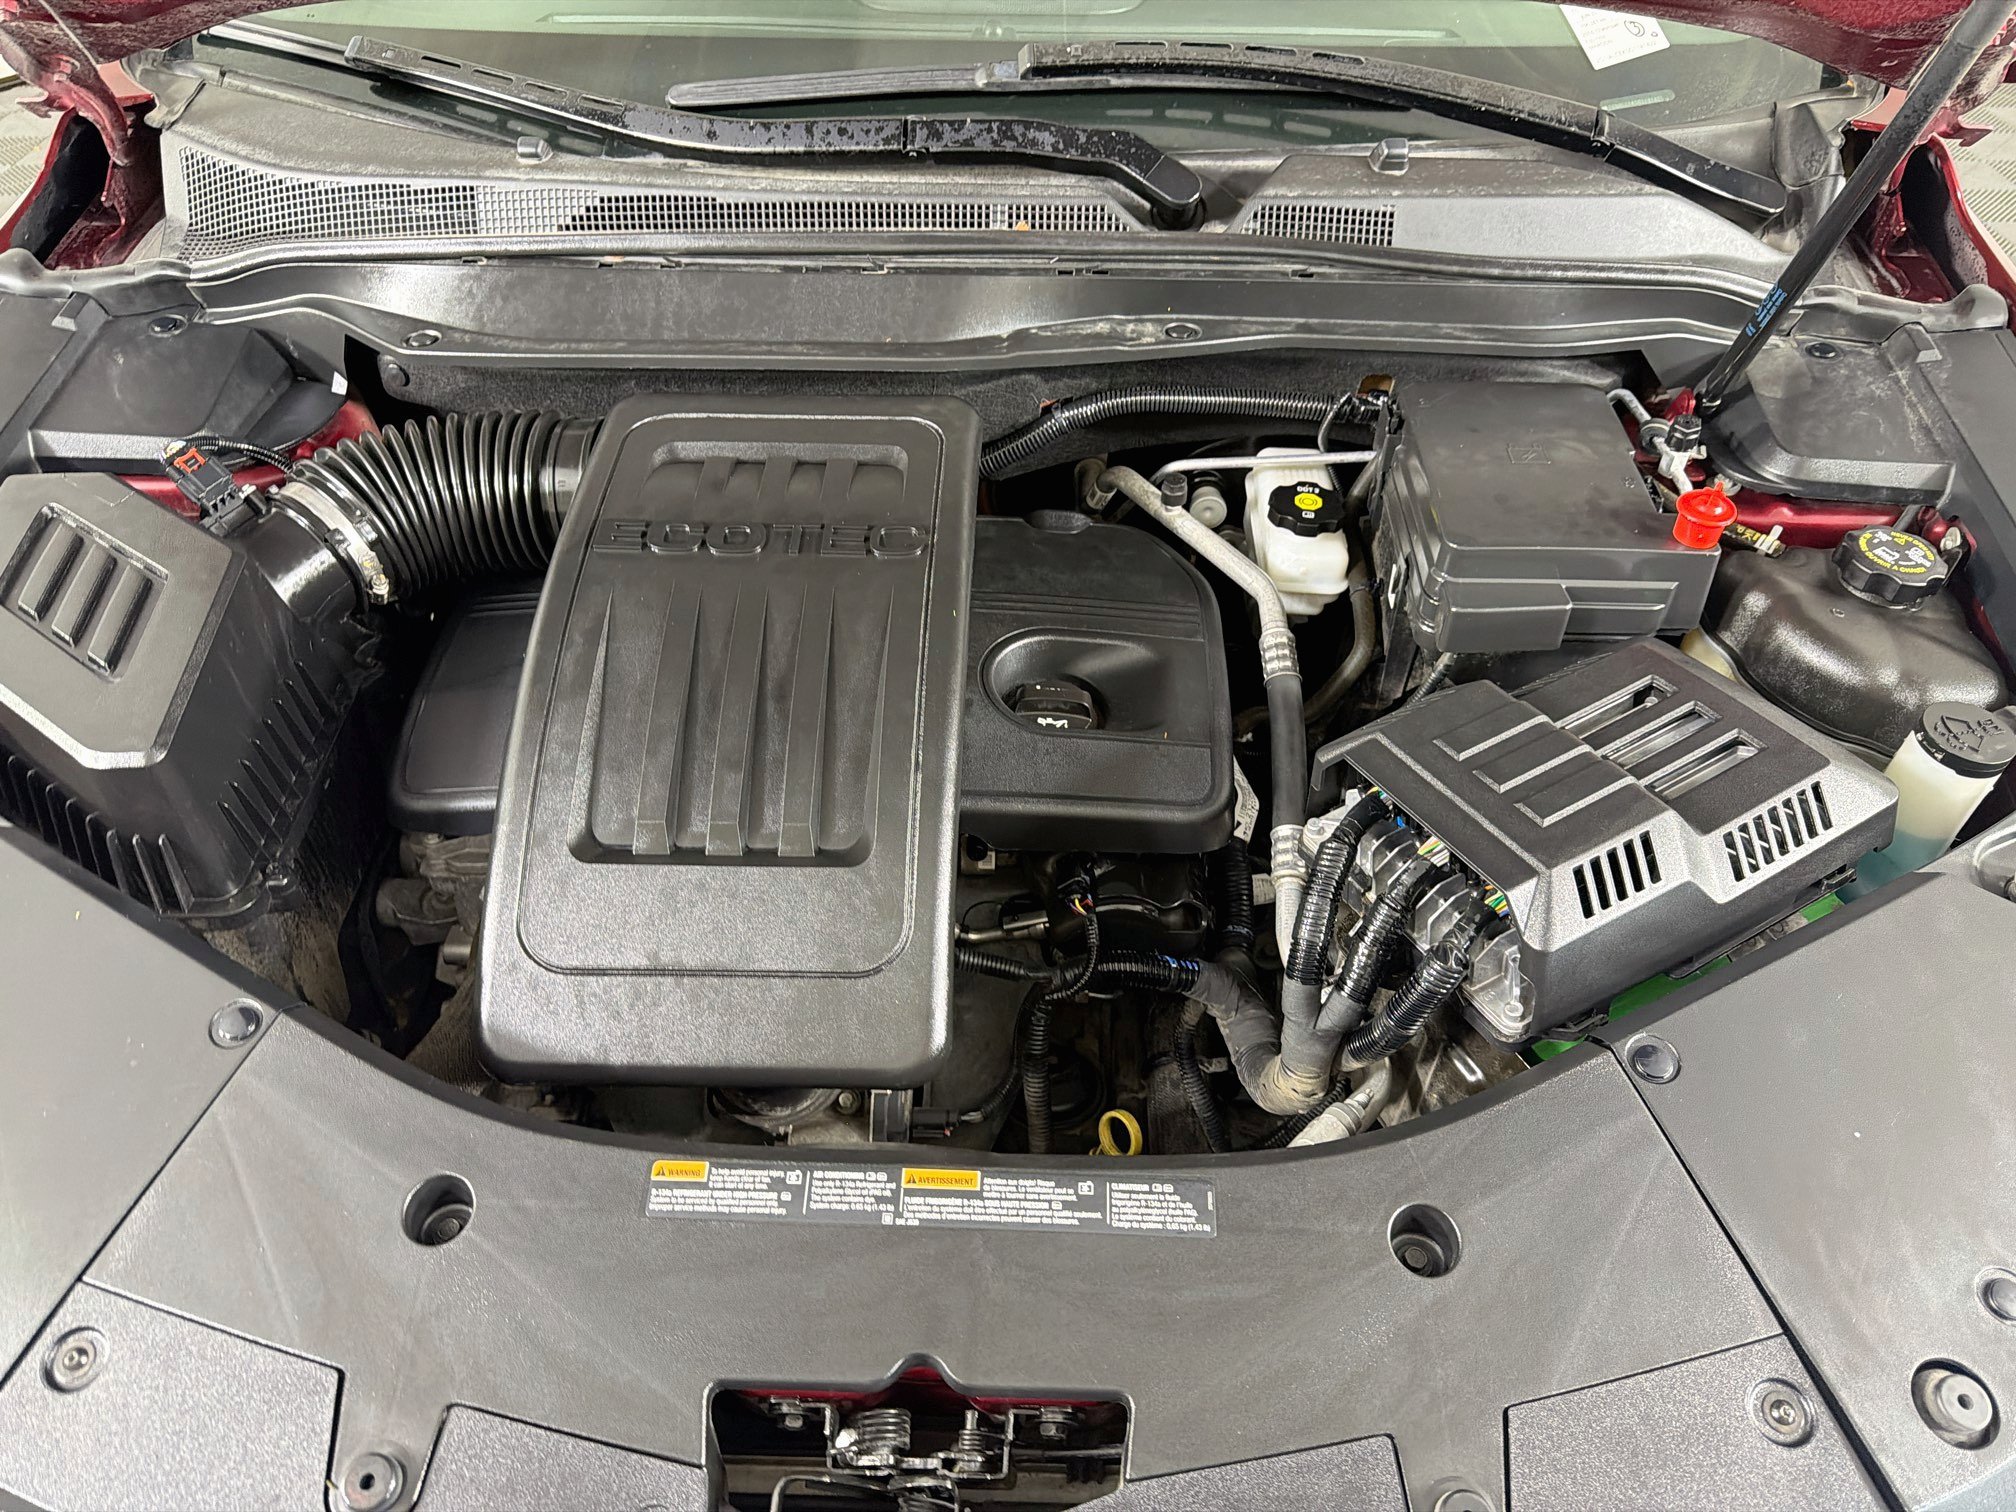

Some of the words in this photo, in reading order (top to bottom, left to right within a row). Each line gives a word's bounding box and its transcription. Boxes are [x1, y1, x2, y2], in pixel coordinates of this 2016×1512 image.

[1297, 485, 1313, 493] DOT
[593, 522, 928, 559] ECOTEC
[918, 1177, 974, 1185] AVERTISSEMENT
